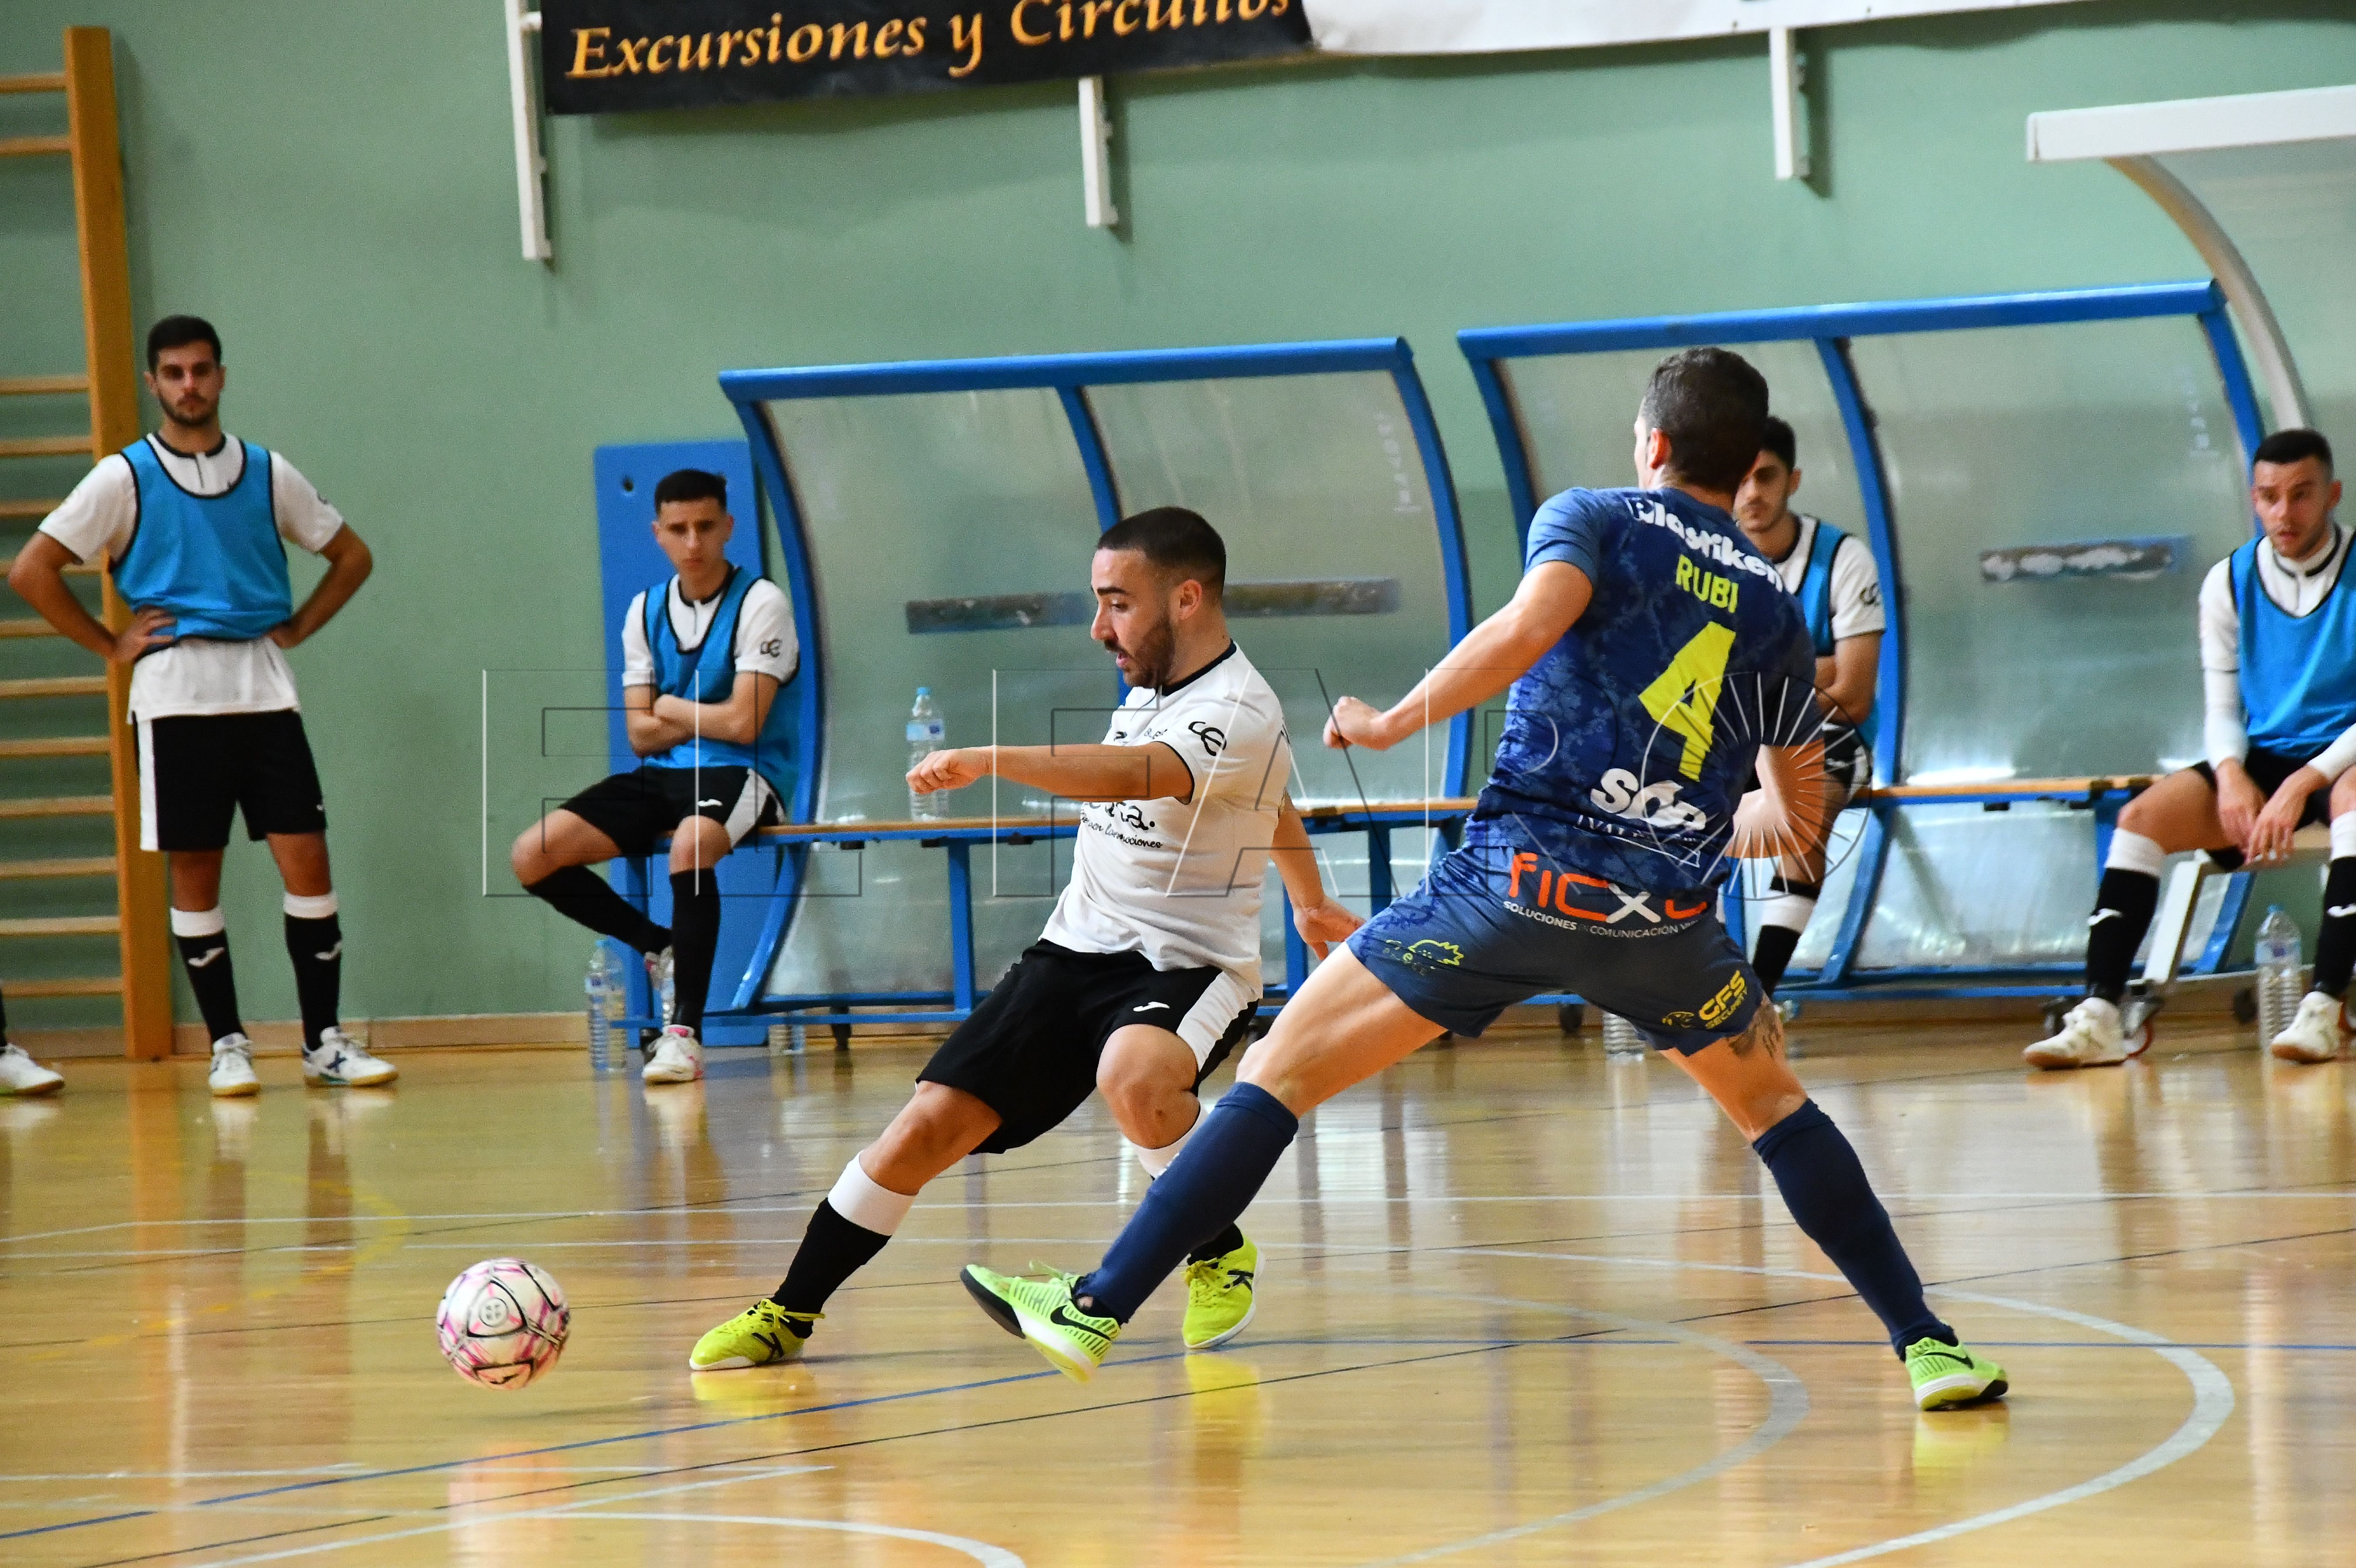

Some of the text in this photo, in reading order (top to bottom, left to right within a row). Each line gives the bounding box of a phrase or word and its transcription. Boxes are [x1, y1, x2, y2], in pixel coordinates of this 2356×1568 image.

[565, 13, 928, 79] Excursiones
[948, 6, 983, 78] y
[1676, 554, 1740, 613] RUBI
[1638, 621, 1737, 782] 4
[1503, 900, 1577, 930] SOLUCIONES
